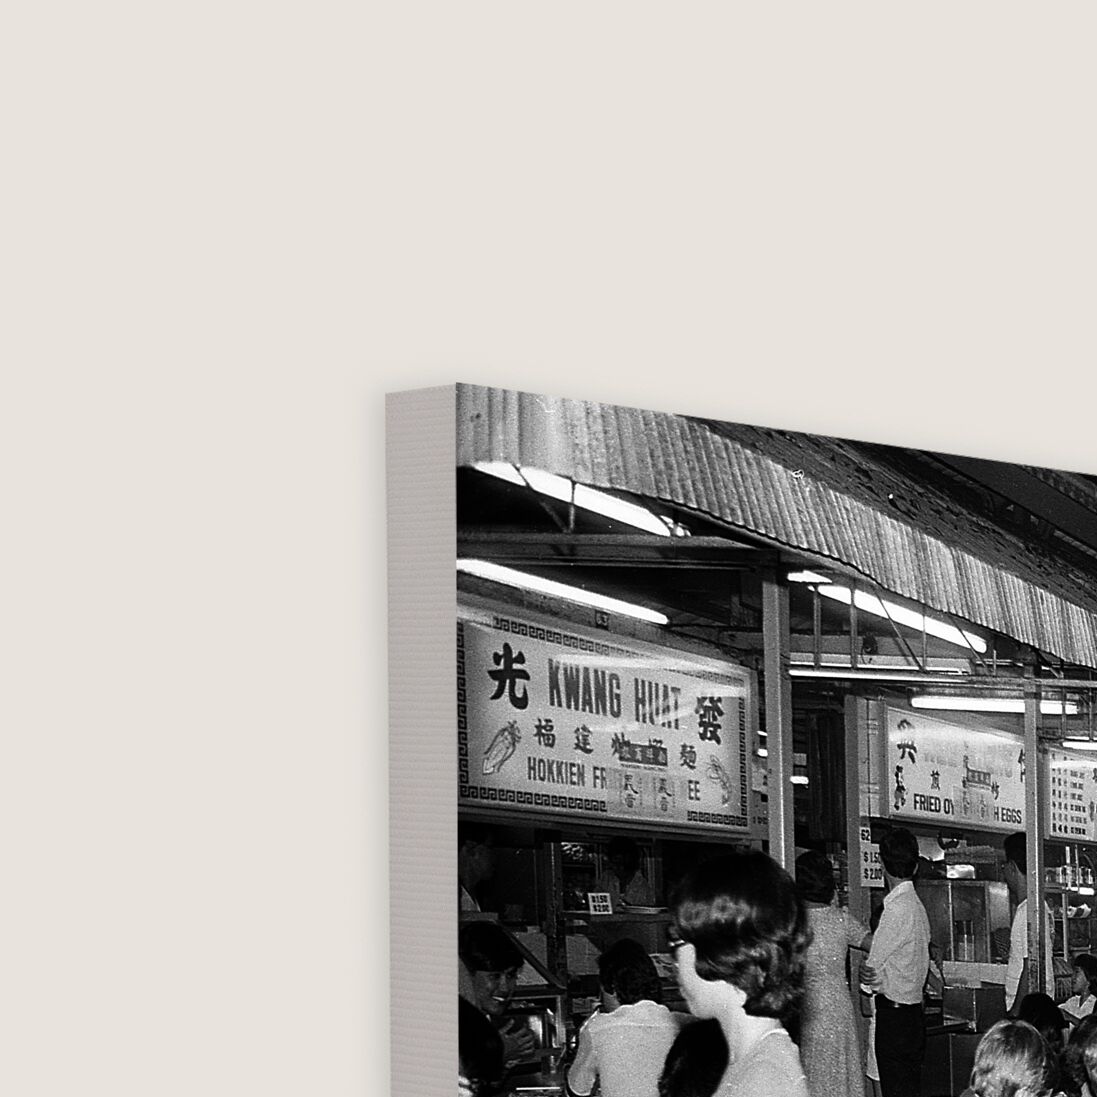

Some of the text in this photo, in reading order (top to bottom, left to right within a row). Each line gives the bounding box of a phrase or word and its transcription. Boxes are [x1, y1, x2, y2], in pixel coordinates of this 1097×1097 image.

[487, 642, 531, 710] 光
[548, 658, 681, 730] KWANG HUAT
[527, 756, 585, 787] HOKKIEN
[687, 779, 700, 801] EE
[914, 793, 942, 813] FRIED
[1001, 806, 1022, 824] EGGS
